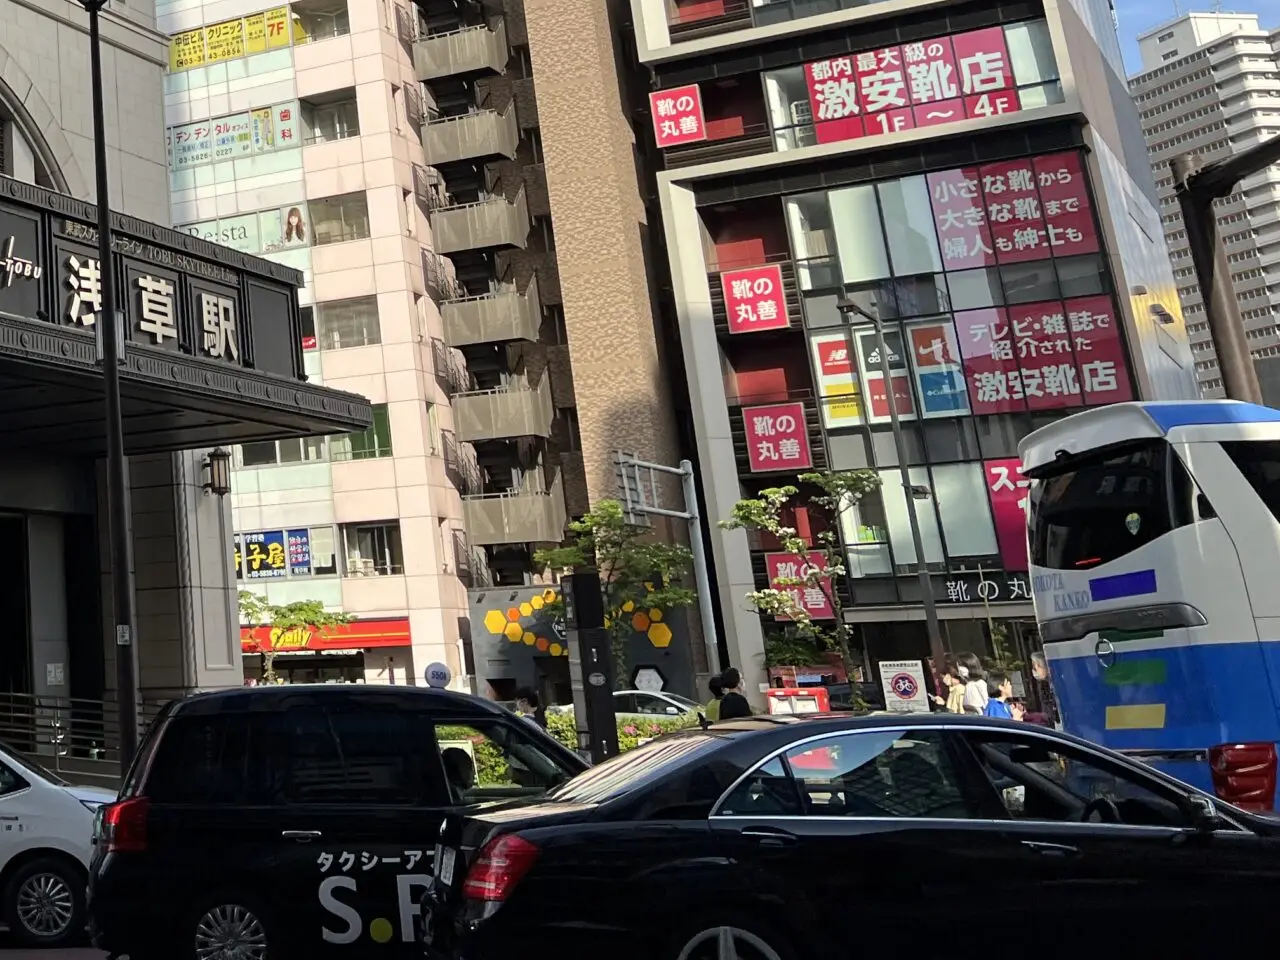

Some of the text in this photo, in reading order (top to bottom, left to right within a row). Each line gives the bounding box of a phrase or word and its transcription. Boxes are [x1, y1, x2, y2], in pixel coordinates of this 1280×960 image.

[267, 21, 285, 37] 7F
[811, 43, 944, 81] 都内最大級の
[814, 51, 1005, 120] 激安靴店
[656, 95, 694, 117] 靴の
[660, 116, 700, 138] 丸善
[934, 168, 1072, 203] 小さな靴から
[939, 197, 1080, 232] 大きな靴まで
[943, 224, 1083, 260] 婦人も紳士も
[731, 276, 773, 300] 靴の
[735, 299, 778, 324] 丸善
[970, 310, 1110, 342] テレビ・雑誌で
[867, 354, 900, 364] adas
[991, 336, 1093, 361] 紹介された
[973, 360, 1117, 402] 激安靴店
[873, 392, 908, 401] REAL
[753, 415, 796, 437] 靴の
[757, 438, 801, 462] 丸善
